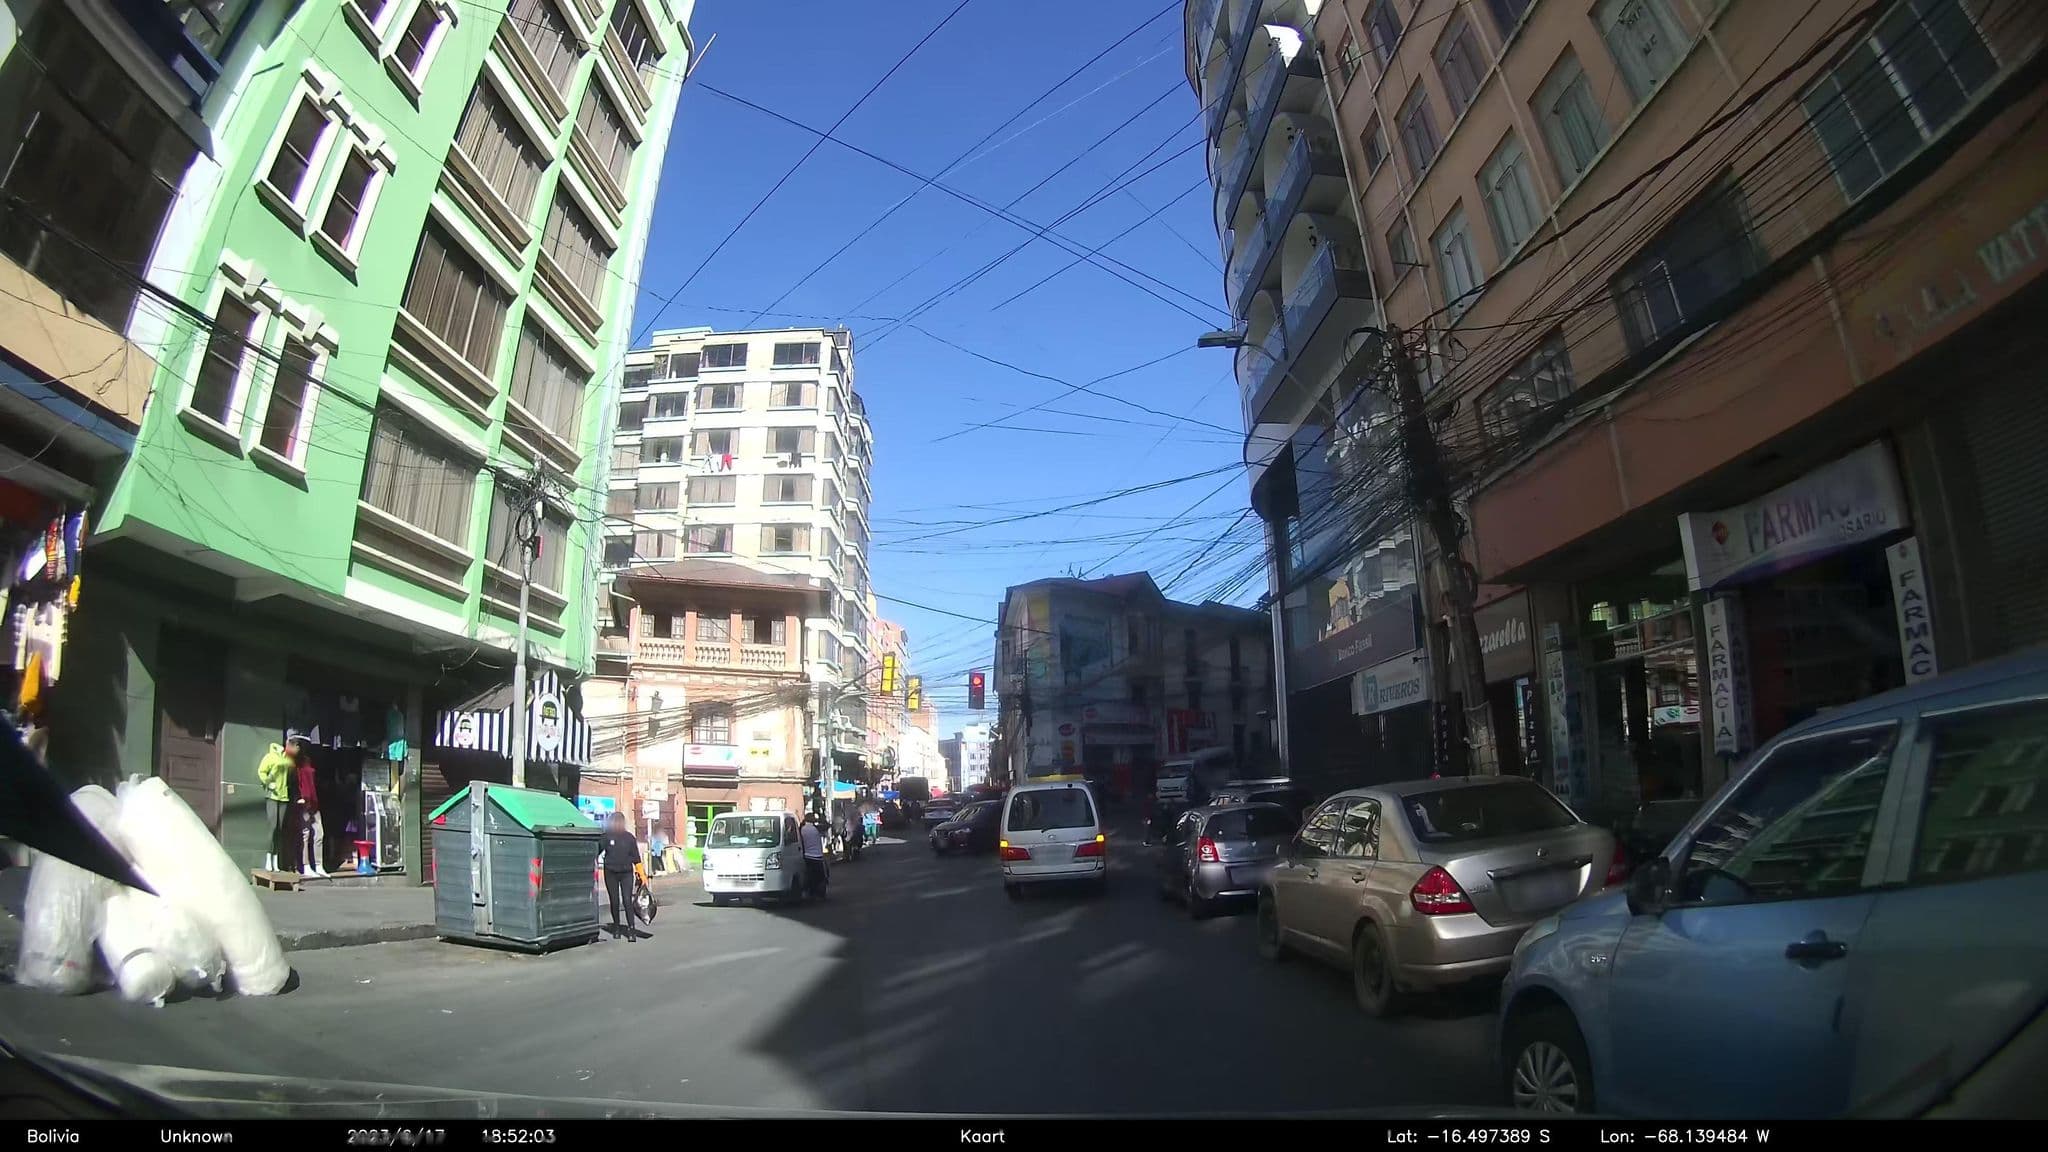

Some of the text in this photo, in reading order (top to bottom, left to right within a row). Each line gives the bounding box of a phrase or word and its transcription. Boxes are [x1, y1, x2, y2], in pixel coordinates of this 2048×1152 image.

[1744, 486, 1862, 554] FARMAC
[1836, 509, 1886, 542] OSARIO
[1899, 568, 1931, 676] FARMAC
[1710, 625, 1732, 737] FARMACIA
[1527, 689, 1538, 759] PIZZA
